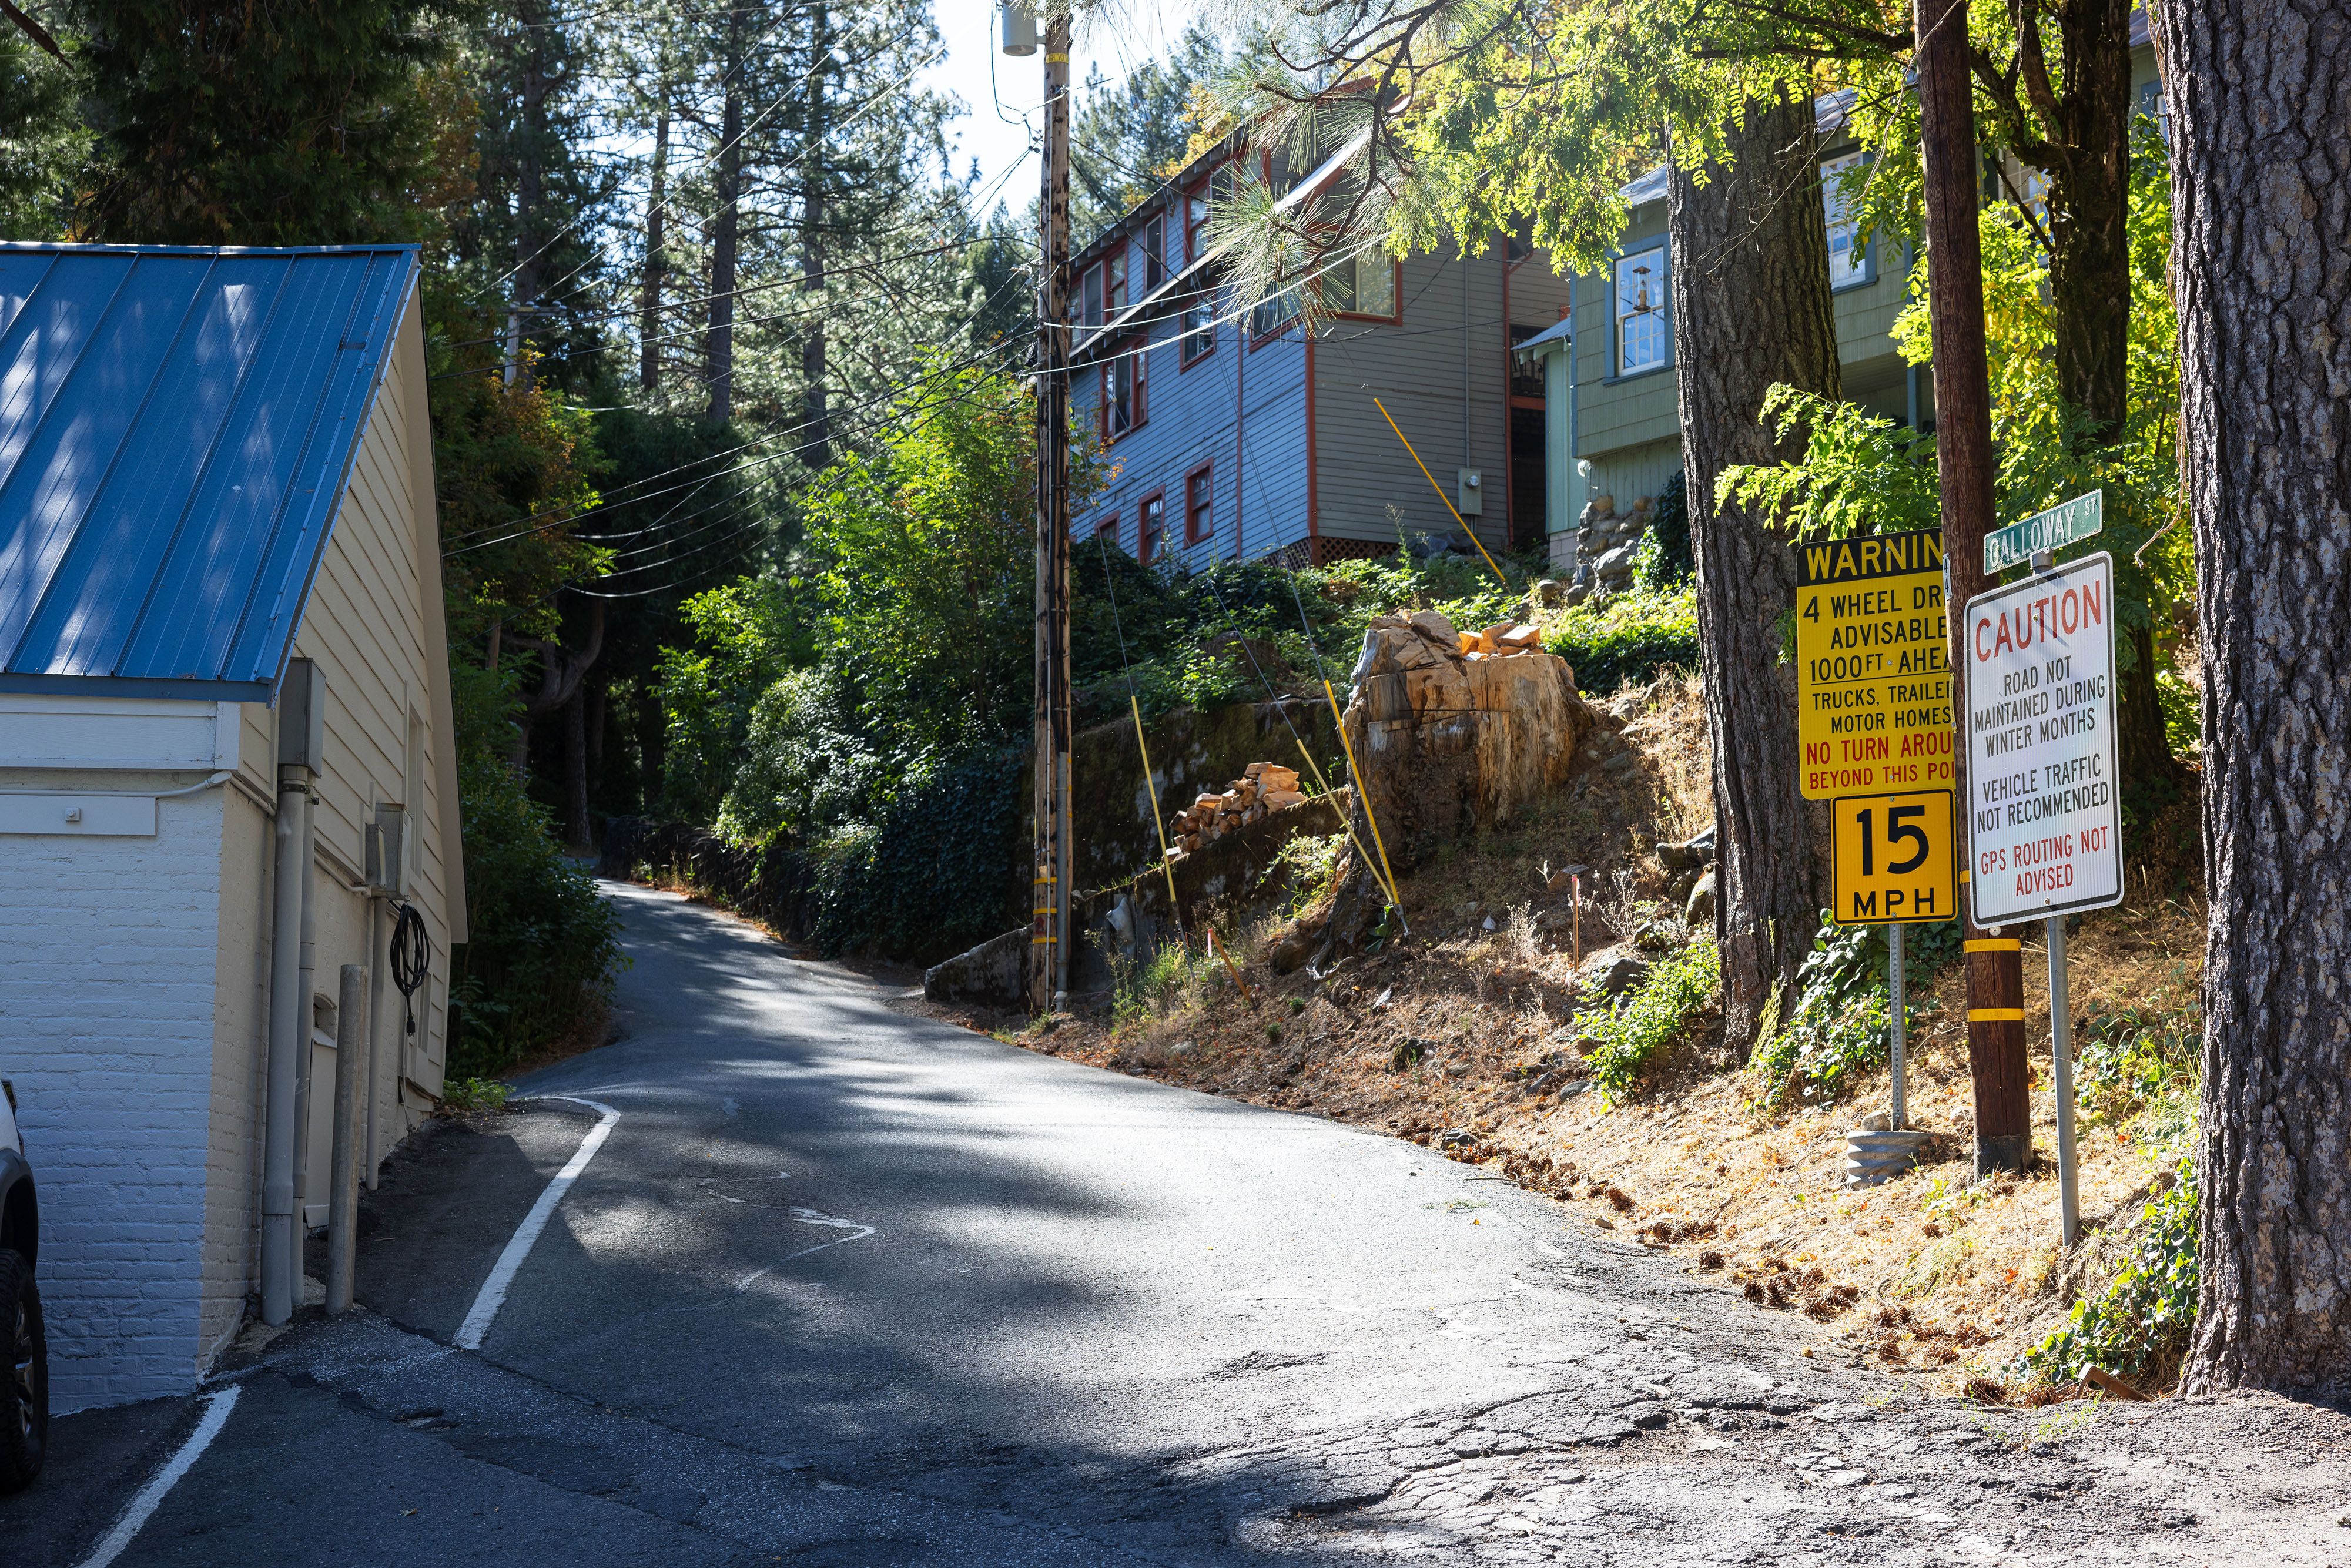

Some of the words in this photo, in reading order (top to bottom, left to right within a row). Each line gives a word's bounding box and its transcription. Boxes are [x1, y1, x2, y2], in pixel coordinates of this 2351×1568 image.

[1990, 505, 2075, 567] GALLOWAY
[2085, 498, 2097, 516] ST
[1806, 532, 1943, 581] WARNIN
[1803, 596, 1819, 623] 4
[1831, 589, 1902, 618] WHEEL
[1975, 580, 2101, 663] CAUTION
[1830, 616, 1947, 650] ADVISABLE
[1810, 653, 1883, 682] 1000FT
[2004, 666, 2038, 697] ROAD
[2046, 655, 2071, 685] NOT
[1812, 688, 1880, 710] TRUCKS,
[1831, 712, 1885, 733] MOTOR
[1895, 706, 1951, 728] HOMES
[1975, 691, 2048, 733] MAINTAINED
[2056, 675, 2105, 711] DURING
[1807, 741, 1831, 765] NO
[1841, 736, 1889, 762] TURN
[1901, 731, 1951, 758] AROU
[1985, 725, 2032, 758] WINTER
[2039, 707, 2095, 743] MONTHS
[1810, 768, 1873, 789] BEYOND
[1882, 764, 1918, 783] THIS
[1928, 761, 1954, 780] POI
[1982, 769, 2038, 803] VEHICLE
[2044, 753, 2101, 789] TRAFFIC
[1977, 806, 2001, 833] NOT
[2008, 782, 2109, 827] RECOMMENDED
[1857, 805, 1929, 876] 15
[1981, 848, 2007, 875] GPS
[2014, 833, 2072, 868] ROUTING
[2081, 826, 2108, 853] NOT
[2016, 863, 2074, 897] ADVISED
[1854, 887, 1934, 917] MPH
